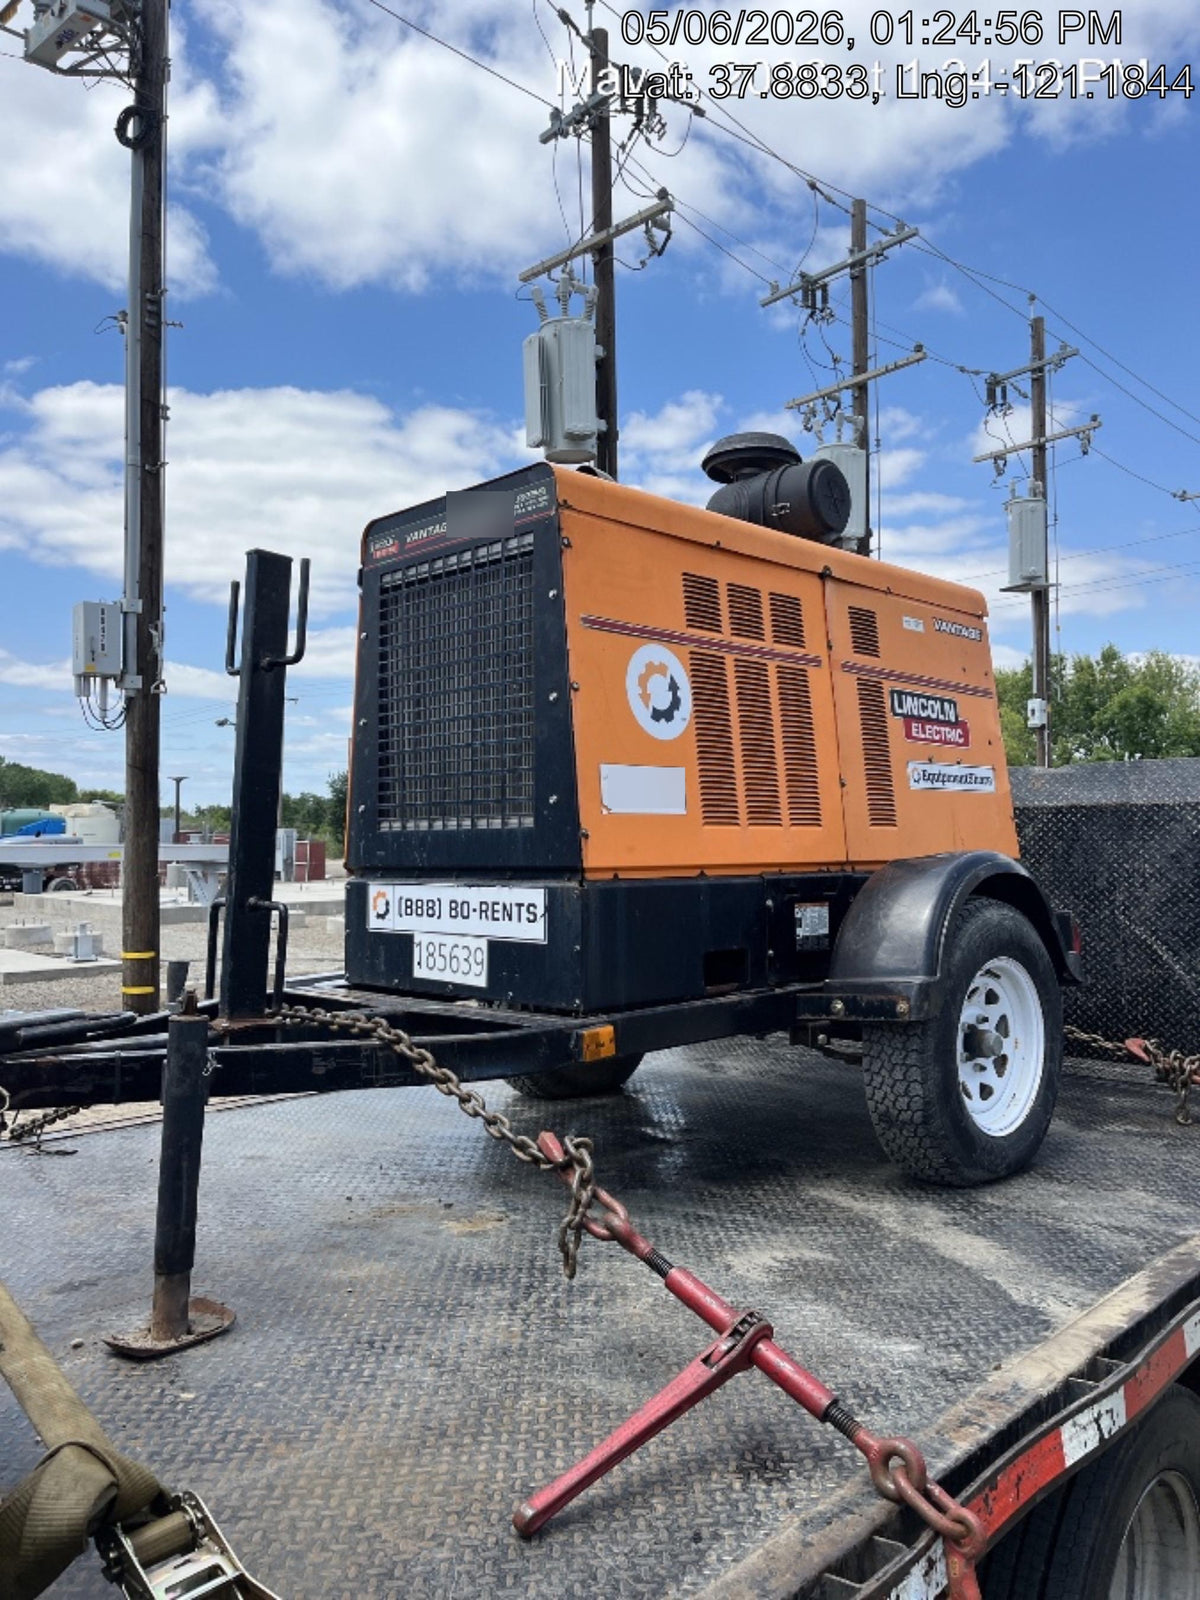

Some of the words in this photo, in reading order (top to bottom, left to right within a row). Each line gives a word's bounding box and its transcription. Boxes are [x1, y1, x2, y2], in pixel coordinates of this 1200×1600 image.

[404, 522, 447, 543] VANTAG
[932, 617, 982, 642] VANTAGE
[893, 692, 956, 723] LINCOLN
[911, 723, 964, 744] ELECTRIC
[414, 940, 485, 977] 185639
